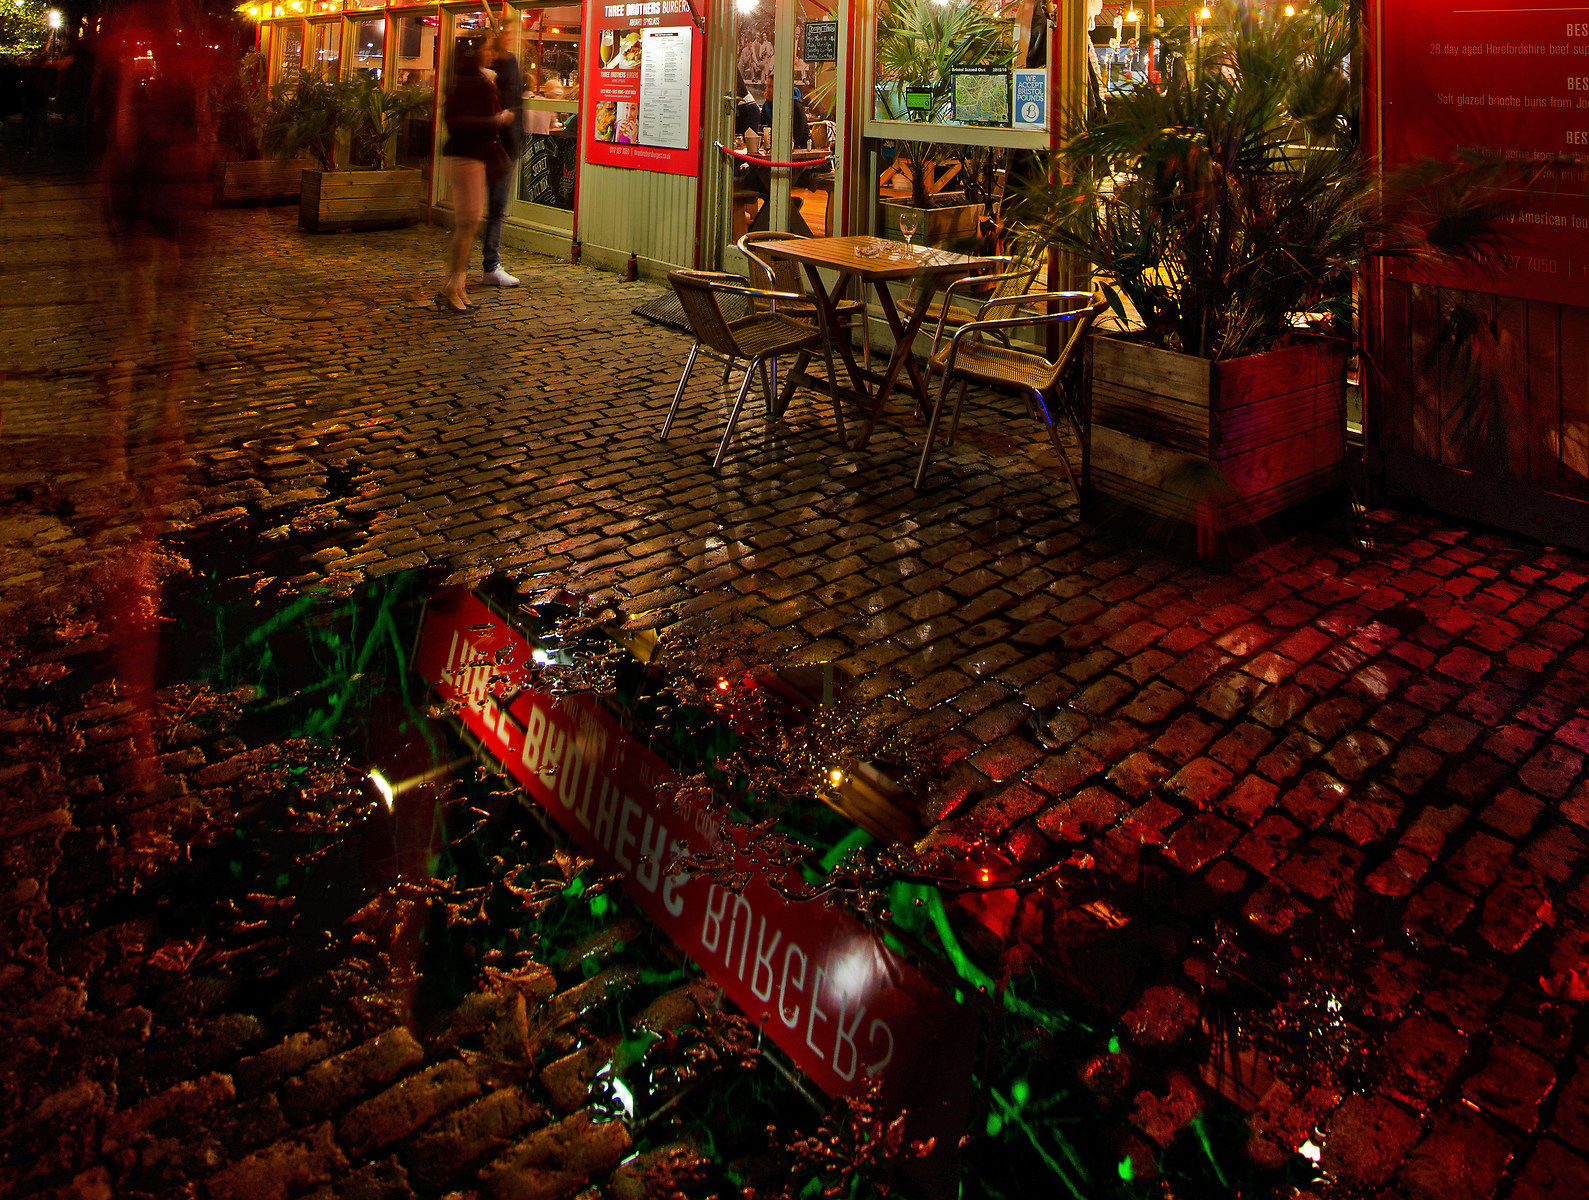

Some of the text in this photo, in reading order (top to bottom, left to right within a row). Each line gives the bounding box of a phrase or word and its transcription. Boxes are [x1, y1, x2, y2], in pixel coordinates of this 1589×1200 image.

[604, 0, 690, 18] THREE BROTHERS BURGERS
[1566, 23, 1589, 37] BES
[1430, 43, 1441, 55] 28
[1444, 43, 1459, 57] day
[1462, 43, 1483, 57] aged
[1486, 43, 1546, 56] Herefordshire
[1549, 43, 1570, 55] beef
[1017, 81, 1044, 89] ACCEPT
[1567, 77, 1589, 91] BES
[1016, 94, 1044, 102] POUNDS
[1017, 88, 1044, 96] BRISTOL
[1437, 93, 1589, 109] Soft glazed brioche buns from Jo
[1566, 131, 1589, 145] BES
[1505, 149, 1530, 160] some
[1518, 211, 1567, 227] American
